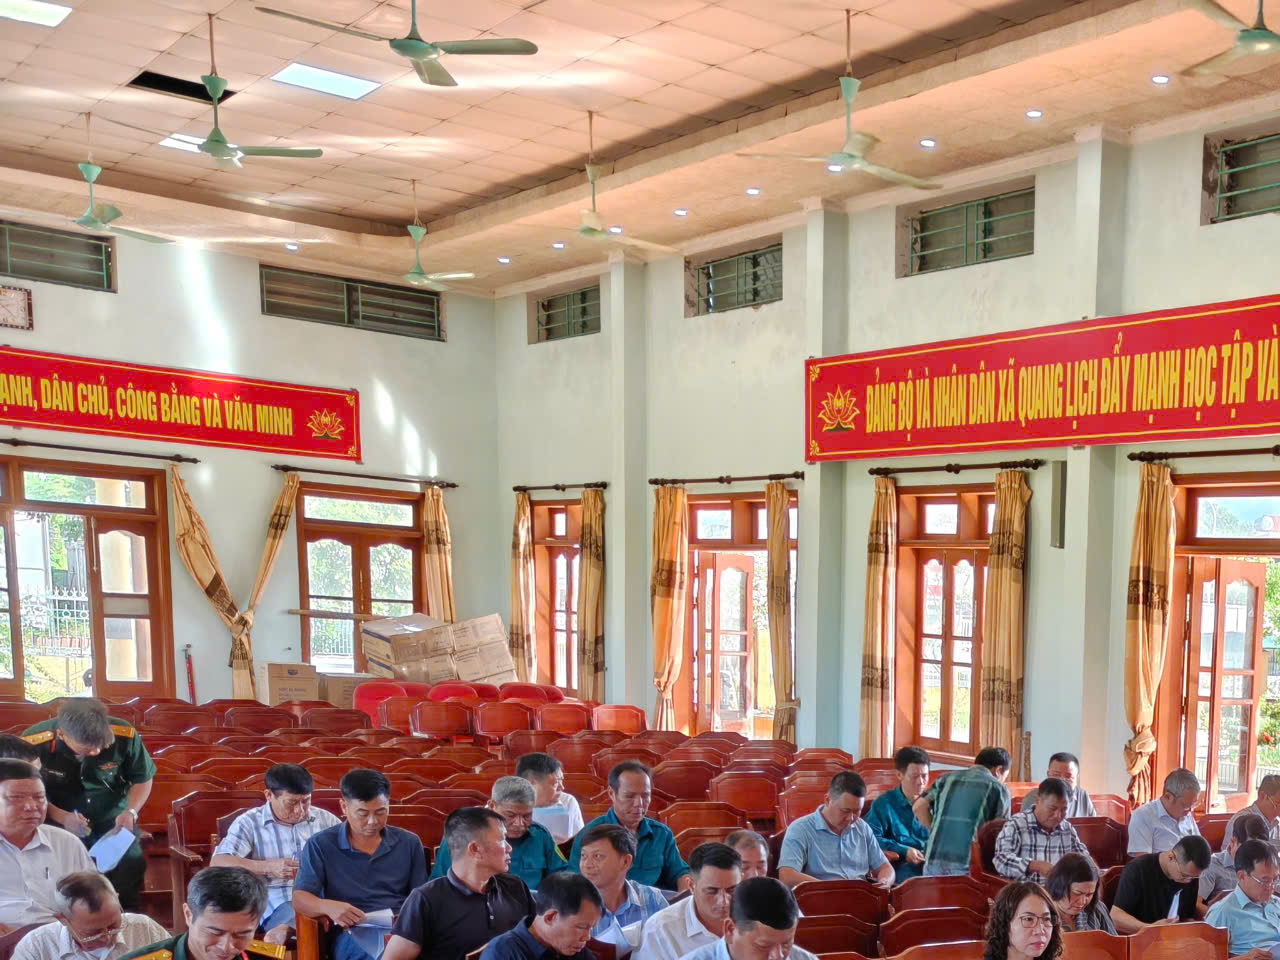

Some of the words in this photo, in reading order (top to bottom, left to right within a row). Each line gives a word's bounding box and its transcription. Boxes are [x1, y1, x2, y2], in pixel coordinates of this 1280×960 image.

[40, 373, 74, 411] DÂN
[77, 375, 113, 420] CHỦ,
[116, 382, 157, 421] CÔNG
[160, 382, 200, 425] BẰNG
[203, 393, 222, 428] VÀ
[224, 396, 253, 431] VĂN
[256, 404, 293, 436] MINH
[866, 367, 896, 433] ĐẢNG
[898, 369, 913, 441] BỘ
[916, 367, 930, 429] VÀ
[933, 363, 967, 427] NHÂN
[969, 360, 995, 424] DÂN
[998, 357, 1015, 422] XÃ
[1018, 362, 1063, 427] QUANG
[1066, 359, 1098, 429] LỊCH
[1101, 331, 1131, 414] ĐẨY
[1132, 350, 1181, 424] MẠNH
[1183, 345, 1217, 421] HỌC
[1221, 329, 1253, 418] TẬP
[1258, 323, 1278, 401] VÀ
